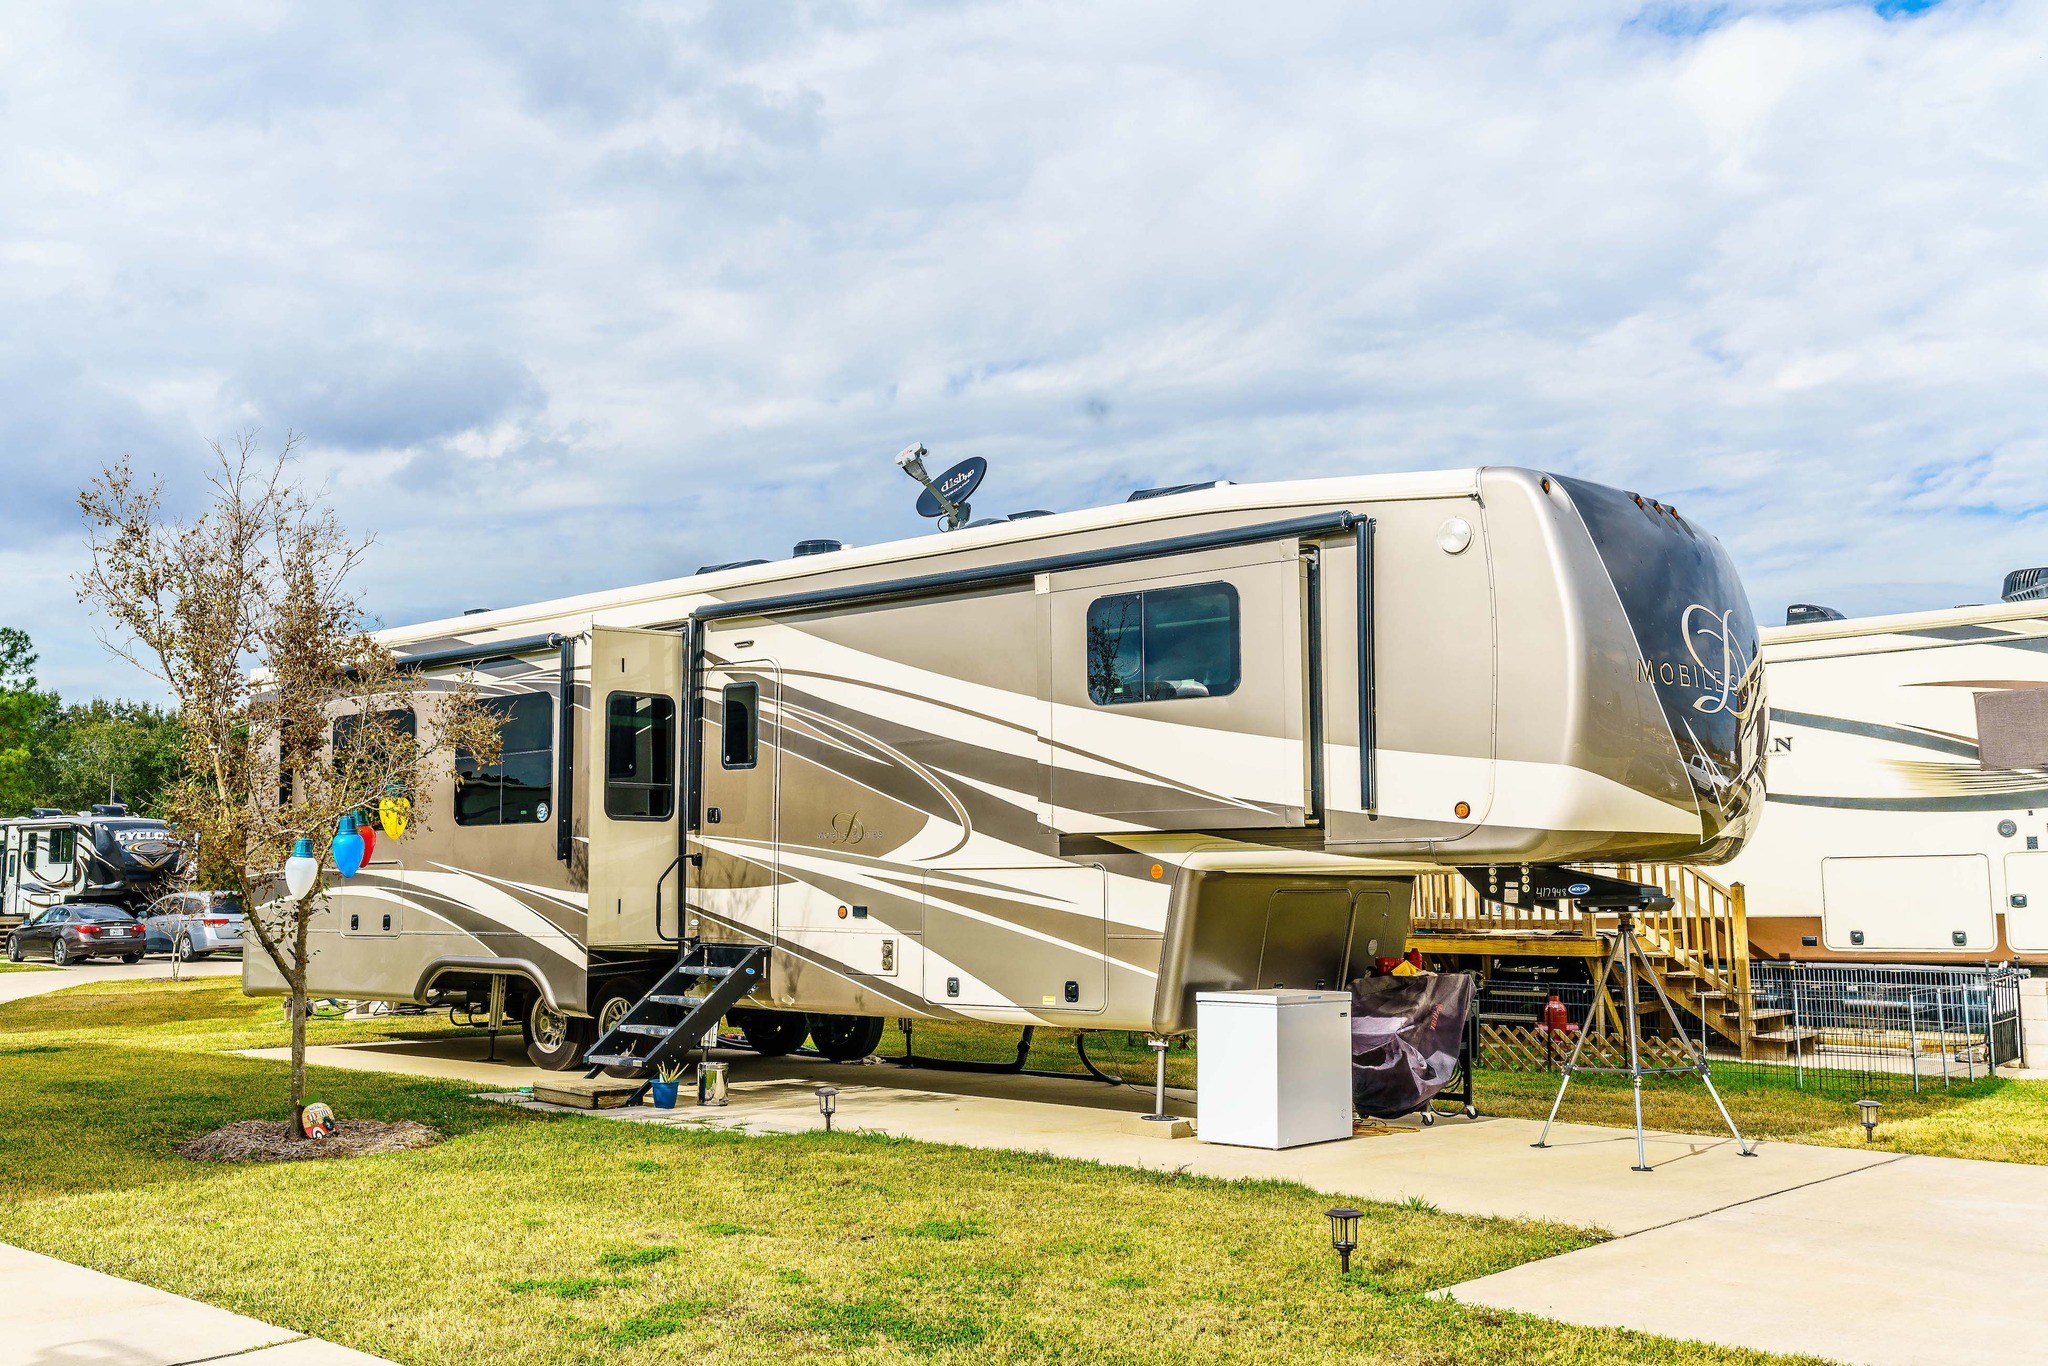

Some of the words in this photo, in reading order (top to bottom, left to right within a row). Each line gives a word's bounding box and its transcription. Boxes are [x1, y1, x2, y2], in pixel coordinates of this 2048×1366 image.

[1635, 658, 1725, 694] MOBILE
[1769, 736, 1793, 753] N
[115, 831, 171, 841] CYCLO
[1536, 887, 1567, 898] 417948
